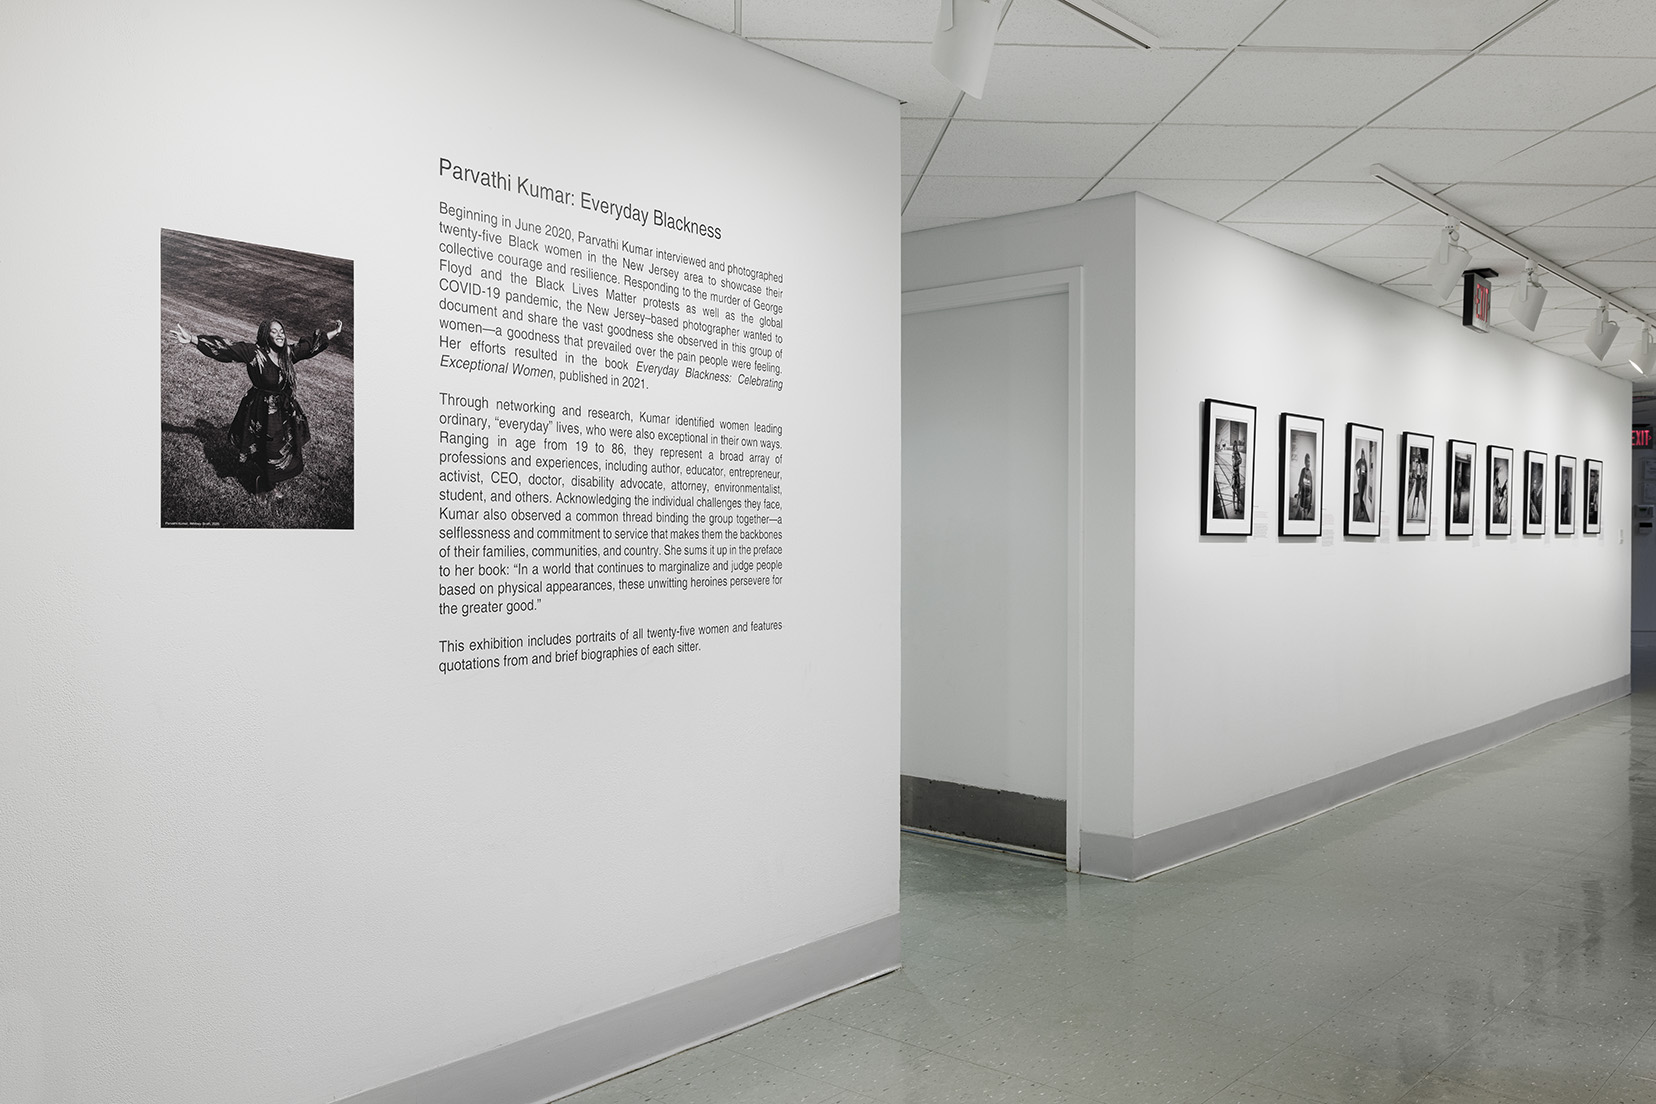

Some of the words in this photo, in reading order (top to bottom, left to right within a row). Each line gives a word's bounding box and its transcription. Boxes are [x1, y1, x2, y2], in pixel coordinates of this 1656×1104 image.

[439, 157, 511, 192] Parvathi
[517, 176, 574, 206] Kumar:
[581, 191, 649, 227] Everyday
[654, 209, 722, 240] Blackness
[439, 201, 498, 228] Beginning
[502, 214, 511, 228] in
[515, 218, 542, 234] June
[545, 224, 574, 243] 2020,
[578, 230, 619, 250] Parvathi
[622, 240, 653, 257] Kumar
[656, 247, 707, 268] interviewed
[709, 261, 725, 272] and
[727, 263, 783, 284] photographed
[439, 242, 494, 262] collective
[498, 253, 543, 272] courage
[546, 262, 566, 275] and
[570, 267, 620, 285] resilience.
[624, 274, 679, 298] Responding
[682, 286, 691, 298] to
[693, 288, 707, 301] the
[710, 293, 741, 306] murder
[743, 297, 751, 308] of
[753, 298, 783, 316] George
[439, 277, 501, 300] COVID-19
[505, 291, 561, 311] pandemic,
[566, 299, 582, 313] the
[587, 302, 610, 316] New
[682, 319, 740, 337] photographer
[743, 330, 772, 342] wanted
[775, 334, 783, 344] to
[439, 297, 498, 318] document
[502, 309, 523, 321] and
[527, 311, 558, 327] share
[562, 316, 579, 329] the
[582, 321, 604, 333] vast
[607, 325, 654, 341] goodness
[657, 331, 674, 344] she
[677, 334, 718, 350] observed
[721, 340, 729, 351] in
[732, 342, 746, 354] this
[749, 346, 772, 359] group
[775, 348, 783, 359] of
[439, 335, 461, 350] Her
[470, 340, 506, 356] efforts
[514, 347, 558, 362] resulted
[565, 351, 574, 364] in
[581, 354, 598, 367] the
[605, 356, 629, 370] book
[636, 360, 680, 379] Everyday
[685, 367, 732, 383] Blackness:
[737, 373, 783, 392] Celebrating
[507, 328, 560, 344] goodness
[564, 334, 583, 348] that
[587, 339, 632, 354] prevailed
[635, 346, 656, 357] over
[659, 347, 674, 360] the
[677, 351, 696, 363] pain
[699, 355, 728, 368] people
[731, 359, 752, 370] were
[754, 360, 782, 377] feeling.
[440, 354, 509, 374] Exceptional
[512, 363, 556, 381] Women,
[559, 370, 608, 385] published
[611, 374, 619, 386] in
[622, 375, 649, 390] 2021.
[439, 392, 489, 412] Through
[496, 400, 556, 418] networking
[562, 405, 581, 417] and
[588, 409, 633, 423] research,
[639, 411, 670, 424] Kumar
[675, 414, 715, 429] identified
[719, 421, 750, 431] women
[754, 421, 783, 437] leading
[439, 450, 507, 466] professions
[510, 455, 531, 467] and
[535, 457, 601, 472] experiences,
[605, 459, 648, 476] including
[651, 462, 682, 475] author,
[685, 464, 726, 477] educator,
[729, 467, 782, 480] entrepreneur,
[439, 469, 483, 485] activist,
[491, 471, 521, 486] CEO,
[528, 473, 565, 488] doctor,
[571, 475, 614, 491] disability
[620, 477, 666, 491] advocate,
[671, 480, 709, 494] attorney,
[714, 482, 782, 495] environmentalist,
[439, 488, 486, 503] student,
[490, 490, 511, 503] and
[515, 491, 552, 504] others.
[555, 492, 632, 509] Acknowledging
[634, 494, 649, 506] the
[652, 495, 694, 507] individual
[696, 496, 742, 511] challenges
[744, 498, 761, 511] they
[763, 498, 782, 510] face,
[439, 507, 479, 520] Kumar
[483, 508, 507, 521] also
[511, 509, 561, 521] observed
[565, 512, 572, 522] a
[575, 512, 619, 522] common
[622, 511, 653, 523] thread
[656, 512, 689, 526] binding
[692, 512, 706, 523] the
[709, 515, 733, 527] group
[439, 526, 511, 539] selflessness
[513, 527, 534, 539] and
[537, 527, 601, 539] commitment
[603, 528, 612, 539] to
[614, 528, 648, 540] service
[650, 528, 668, 539] that
[670, 528, 700, 540] makes
[701, 528, 723, 539] them
[725, 529, 738, 540] the
[740, 529, 783, 540] backbones
[439, 582, 475, 596] based
[479, 584, 494, 595] on
[498, 580, 542, 597] physical
[546, 581, 615, 595] appearances,
[618, 578, 645, 590] these
[648, 577, 688, 591] unwitting
[690, 576, 728, 587] heroines
[730, 577, 770, 589] persevere
[772, 574, 783, 585] for
[438, 602, 458, 615] the
[461, 601, 503, 617] greater
[438, 639, 465, 653] This
[469, 636, 523, 651] exhibition
[527, 633, 572, 647] includes
[575, 630, 616, 646] portraits
[619, 628, 629, 641] of
[632, 628, 643, 640] all
[647, 625, 695, 640] twenty-five
[698, 625, 730, 635] women
[732, 621, 748, 633] and
[750, 621, 783, 632] features
[438, 656, 500, 675] quotations
[503, 654, 528, 667] from
[531, 651, 552, 665] and
[555, 649, 578, 663] brief
[581, 646, 638, 663] biographies
[640, 644, 650, 656] of
[652, 642, 675, 655] each
[677, 641, 701, 653] sitter.
